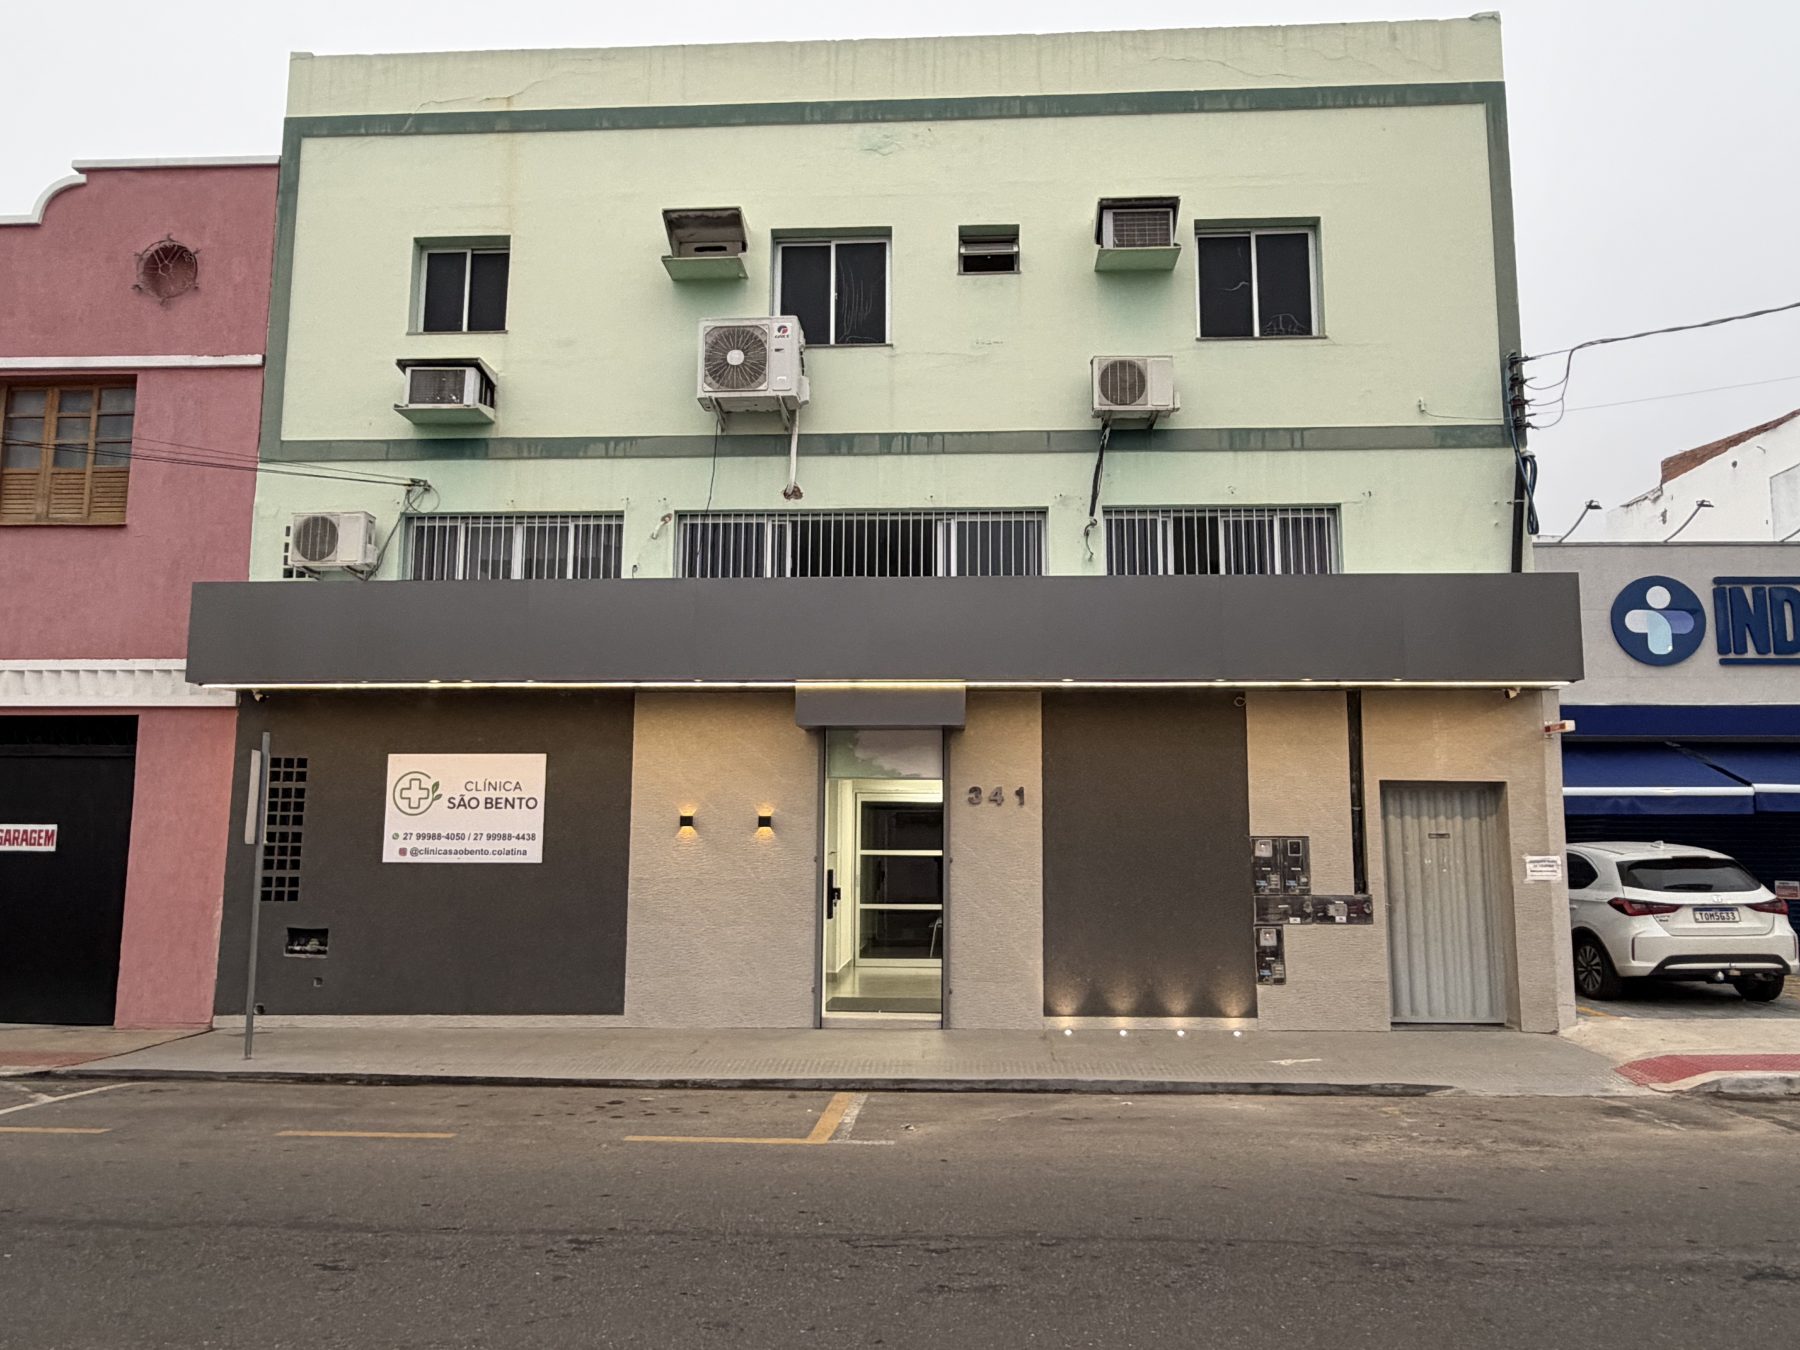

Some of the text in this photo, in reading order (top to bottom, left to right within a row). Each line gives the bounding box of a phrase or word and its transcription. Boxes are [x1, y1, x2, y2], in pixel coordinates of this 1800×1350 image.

[464, 778, 523, 792] CLÍNICA
[447, 794, 538, 810] SÃO BENTO
[968, 786, 1025, 806] 341
[402, 832, 413, 841] 27
[473, 832, 484, 841] 27
